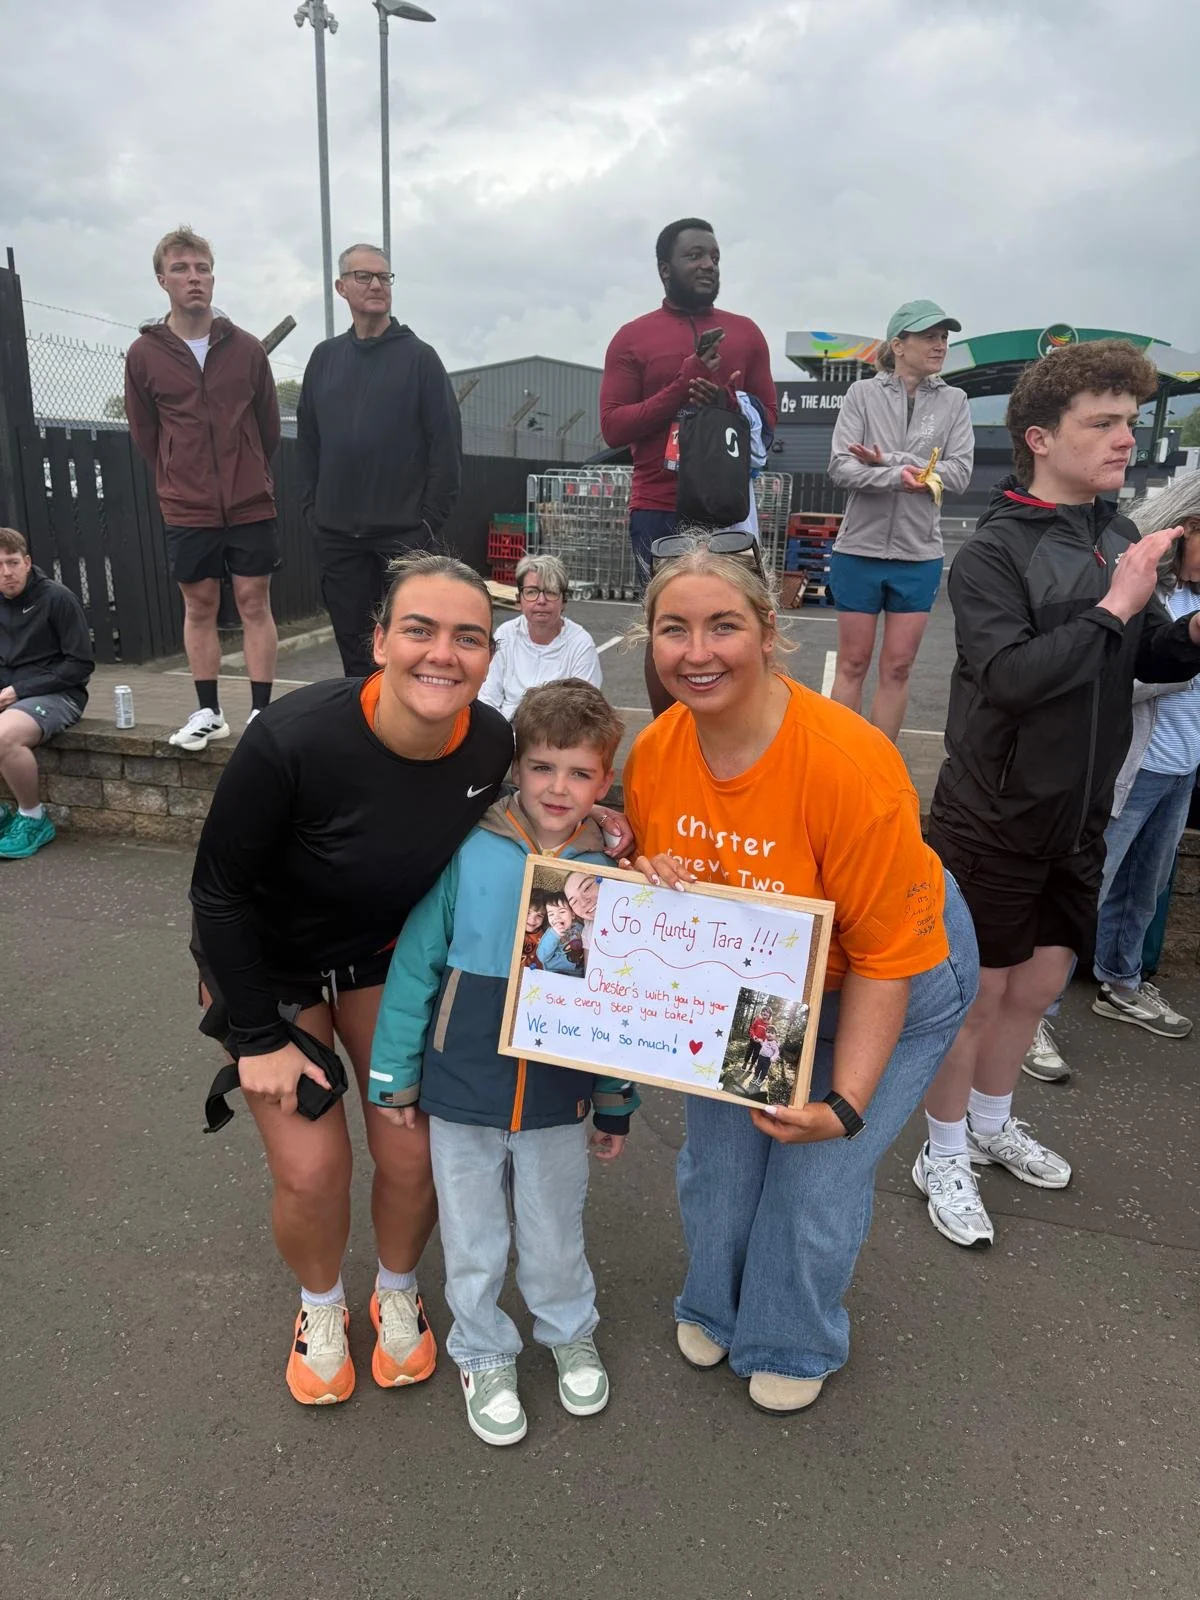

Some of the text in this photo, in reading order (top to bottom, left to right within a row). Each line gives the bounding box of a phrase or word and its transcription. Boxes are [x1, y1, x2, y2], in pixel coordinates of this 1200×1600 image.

[801, 395, 846, 409] THE ALCO
[738, 869, 785, 894] Two
[611, 896, 779, 956] Go Aunty Tara !!!
[588, 967, 729, 1015] Chester's with you by your
[574, 997, 601, 1015] every
[640, 1007, 658, 1021] you
[664, 1008, 694, 1024] take!
[526, 1011, 548, 1034] We
[557, 1019, 582, 1037] love
[638, 1033, 678, 1055] much!
